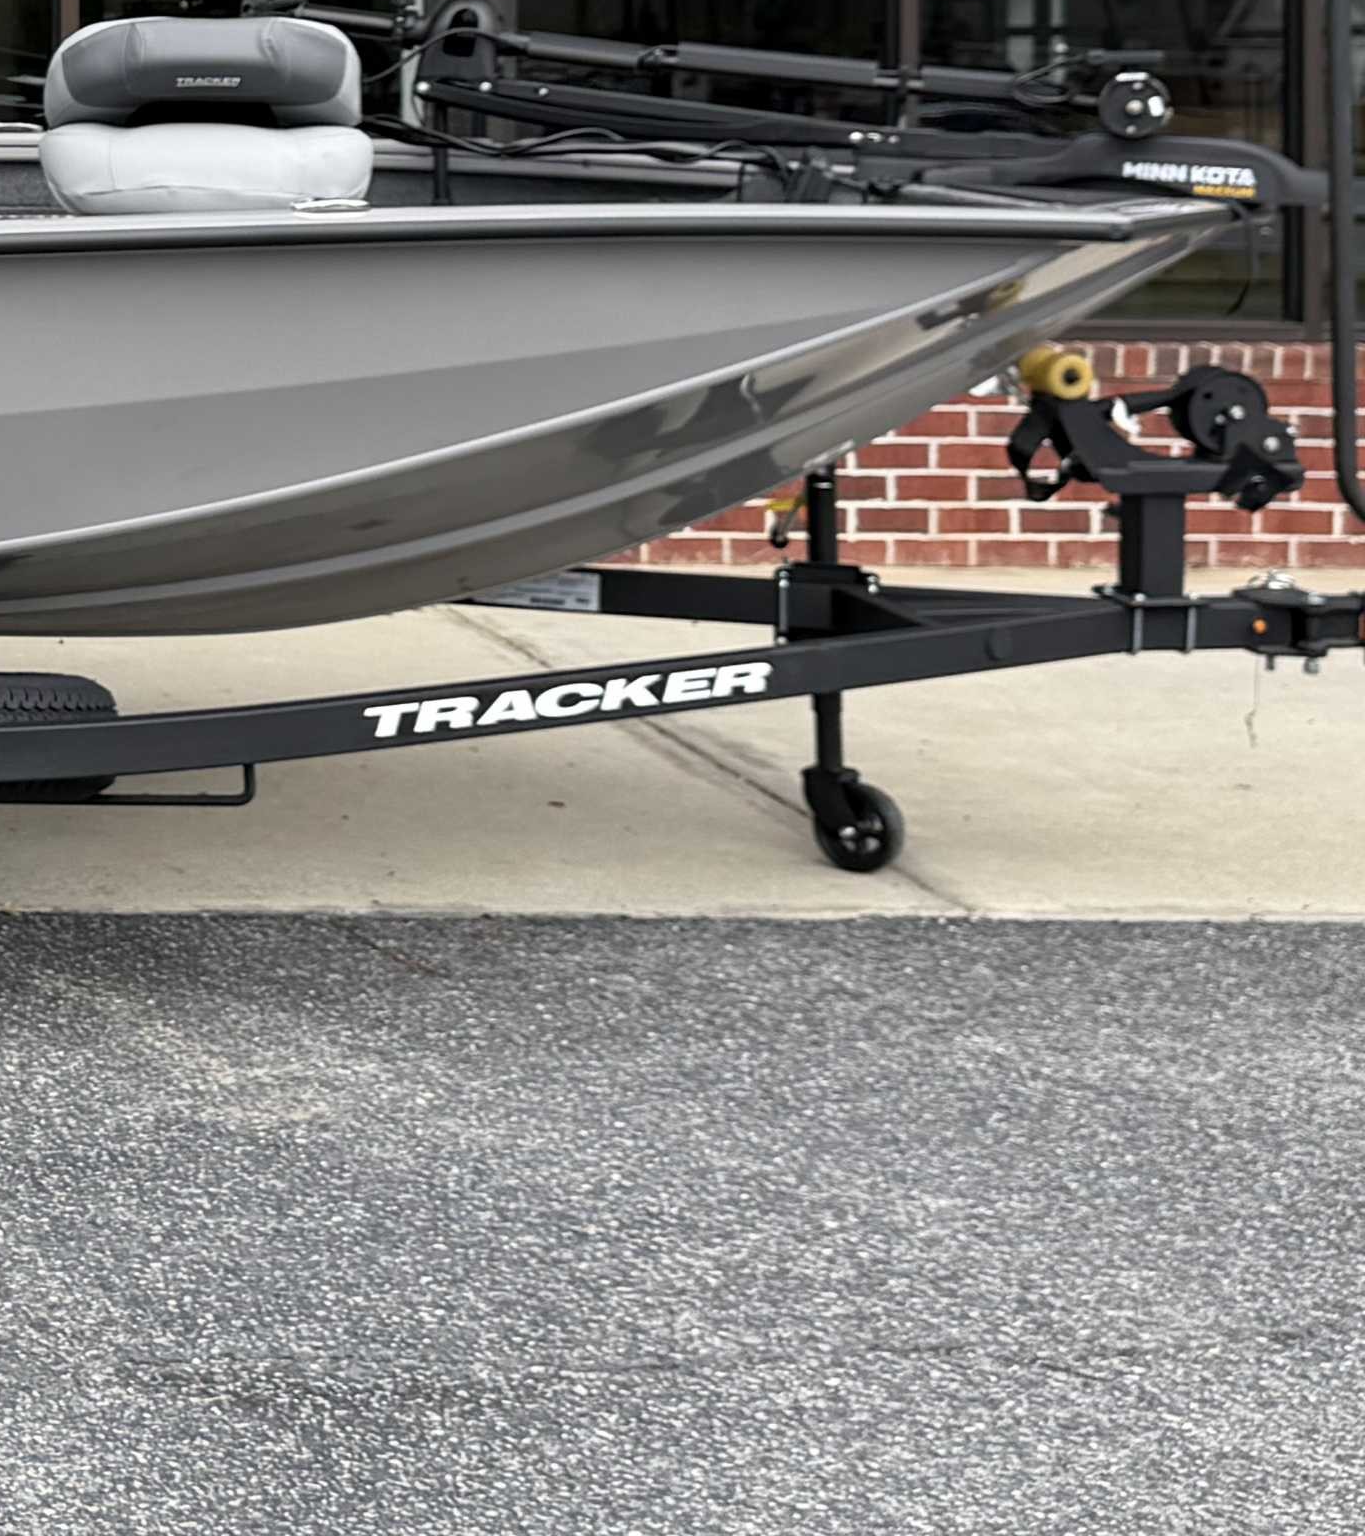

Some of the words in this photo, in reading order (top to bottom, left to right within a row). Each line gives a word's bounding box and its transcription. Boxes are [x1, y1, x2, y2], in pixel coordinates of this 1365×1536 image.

[176, 76, 242, 88] TRACKER
[1121, 161, 1189, 183] MINN
[1190, 165, 1256, 187] KOTA
[362, 661, 773, 740] TRACKER
